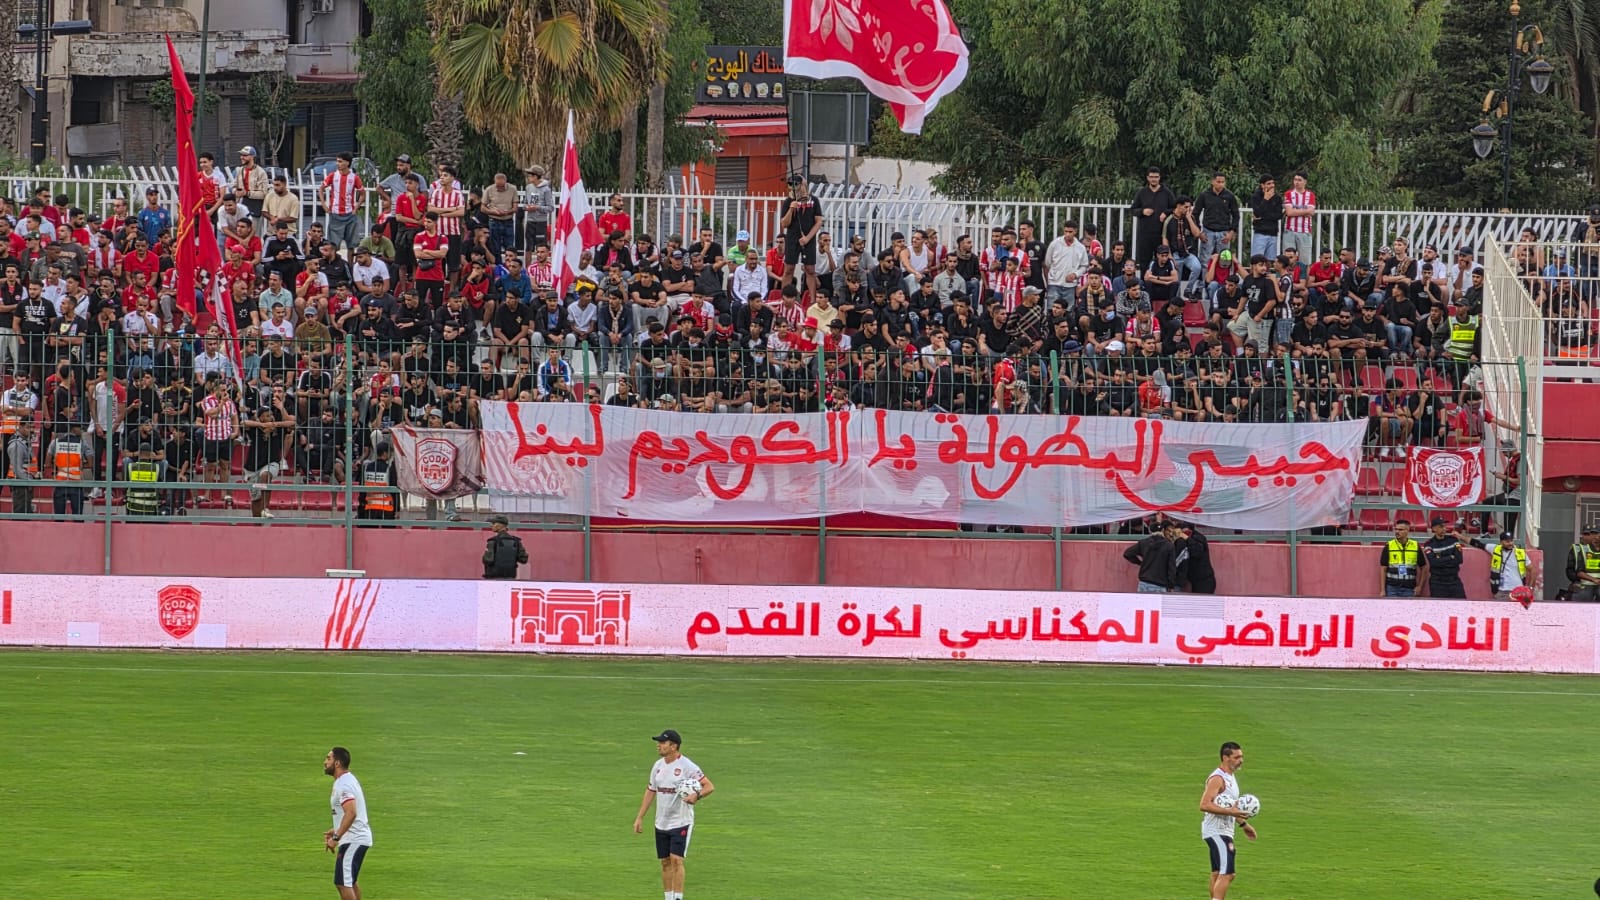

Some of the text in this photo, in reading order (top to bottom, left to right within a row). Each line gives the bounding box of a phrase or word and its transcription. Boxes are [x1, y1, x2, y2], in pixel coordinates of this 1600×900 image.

[706, 49, 749, 82] الهودج
[506, 401, 604, 468] لينا
[625, 410, 850, 500] الكوديم
[868, 409, 917, 471] يا
[935, 413, 1163, 500] البطولة
[686, 602, 1510, 668] النادي الرياضي المكناسي لكرة القدم
